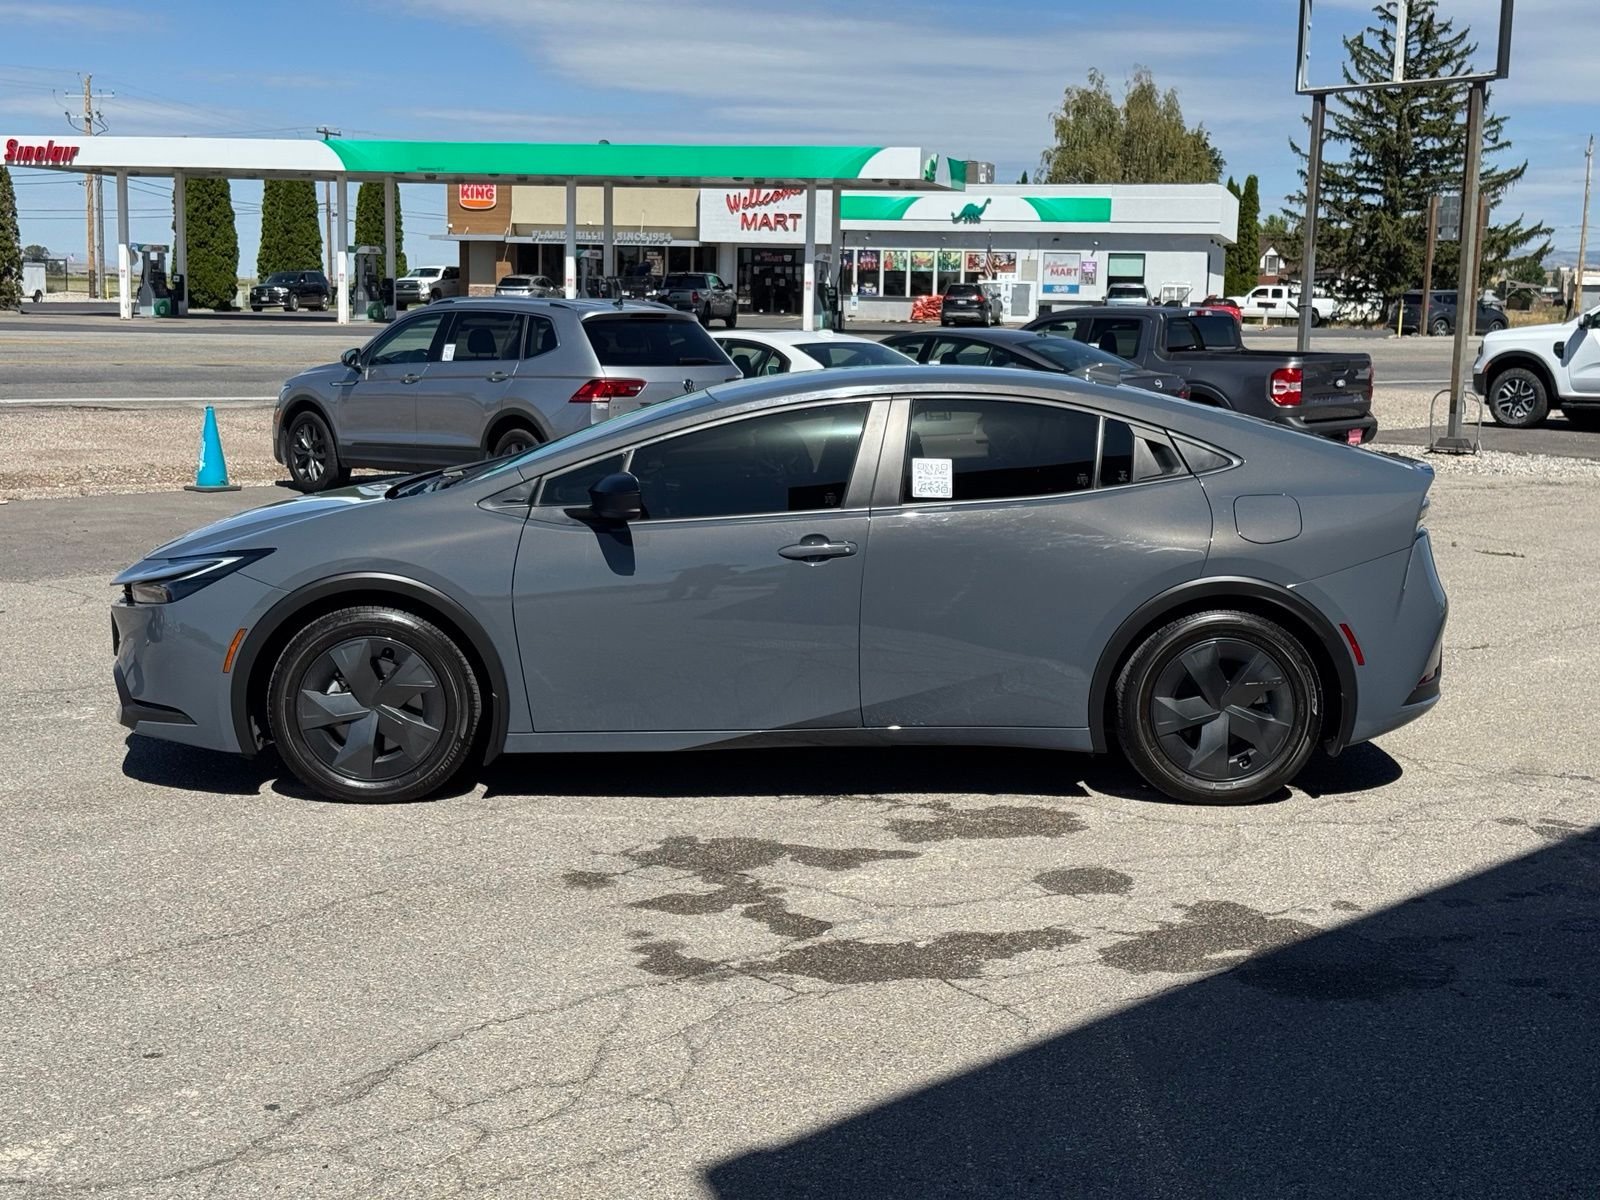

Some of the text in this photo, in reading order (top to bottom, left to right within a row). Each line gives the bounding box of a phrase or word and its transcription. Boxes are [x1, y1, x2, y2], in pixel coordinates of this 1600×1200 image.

[4, 138, 80, 163] Sinclair
[461, 187, 494, 200] KING
[741, 213, 802, 232] MART
[616, 231, 647, 244] SINCE
[1050, 268, 1078, 276] MART
